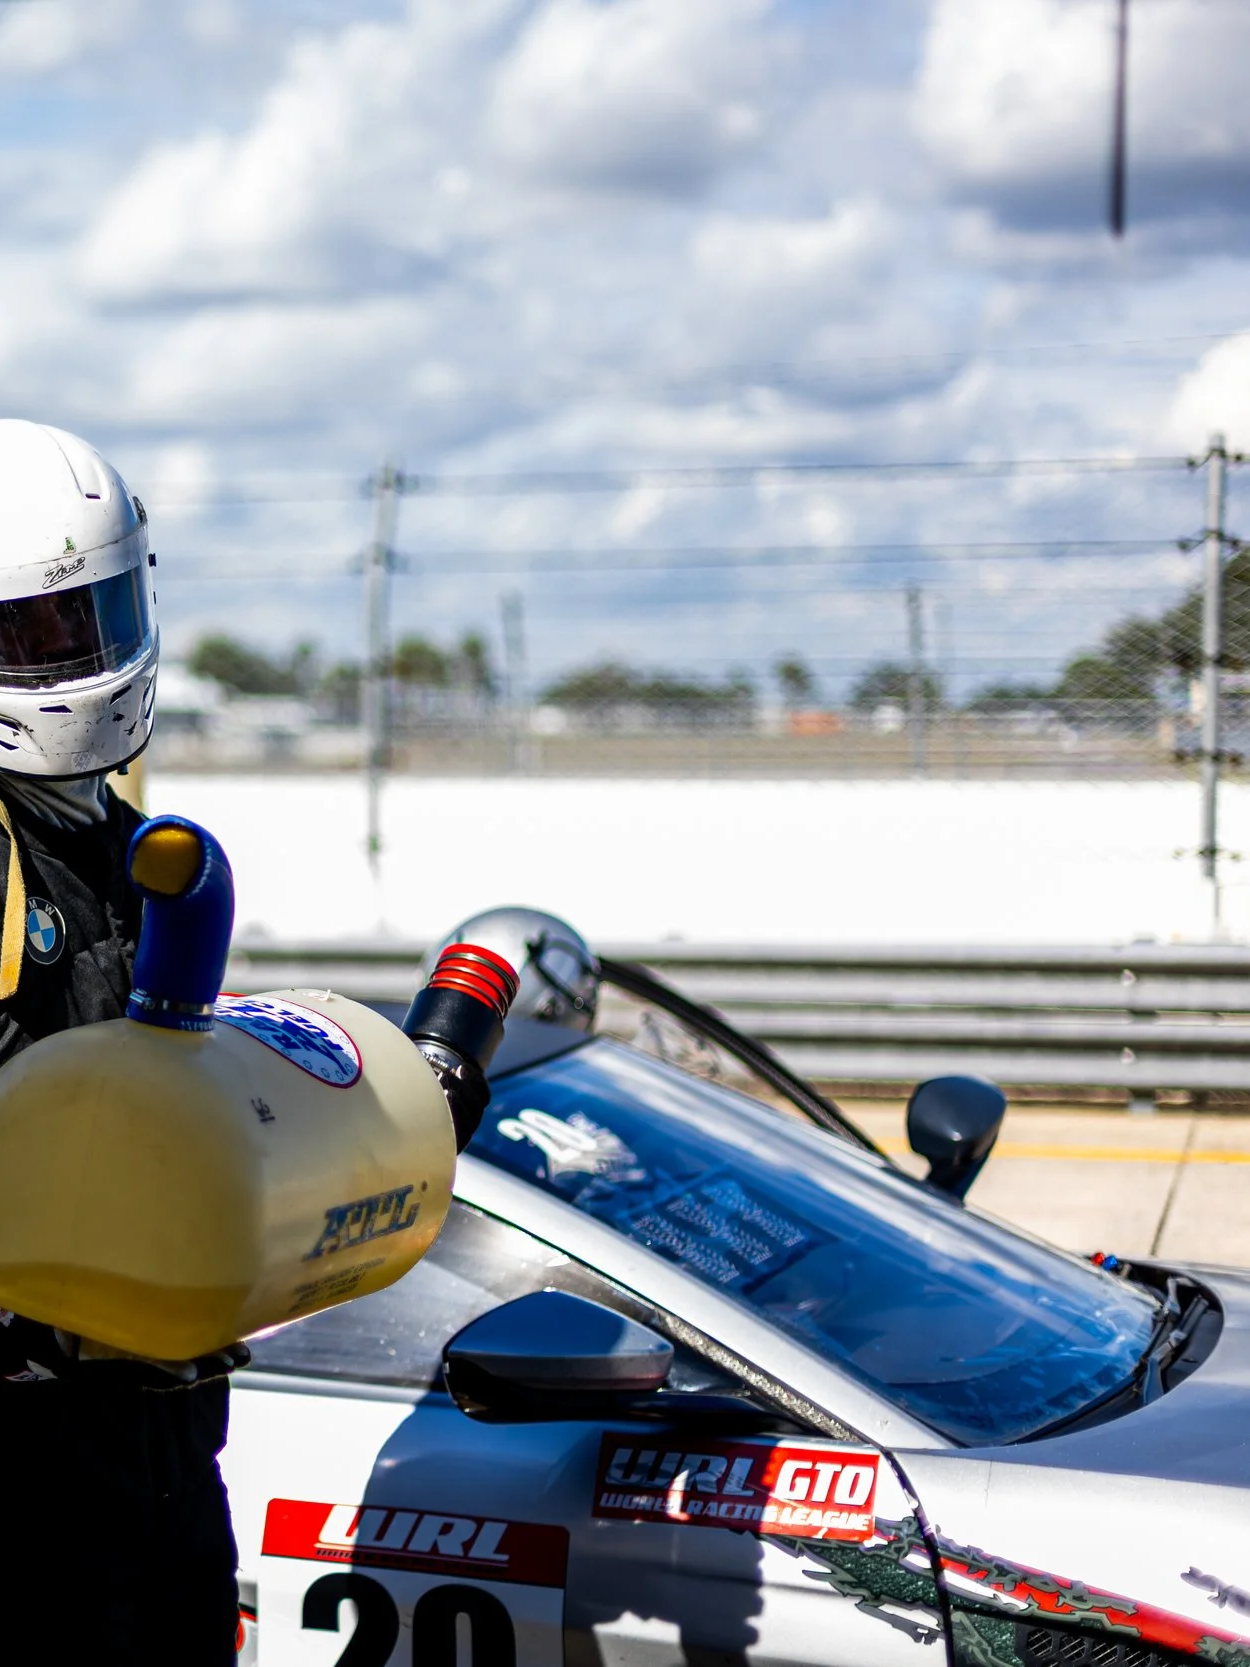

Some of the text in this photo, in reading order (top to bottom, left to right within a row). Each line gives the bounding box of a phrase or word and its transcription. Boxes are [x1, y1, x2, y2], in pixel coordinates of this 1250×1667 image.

[605, 1448, 875, 1506] WRL GTO
[318, 1504, 510, 1562] WRL
[778, 1508, 873, 1532] LEAGUE
[301, 1571, 517, 1667] 20
